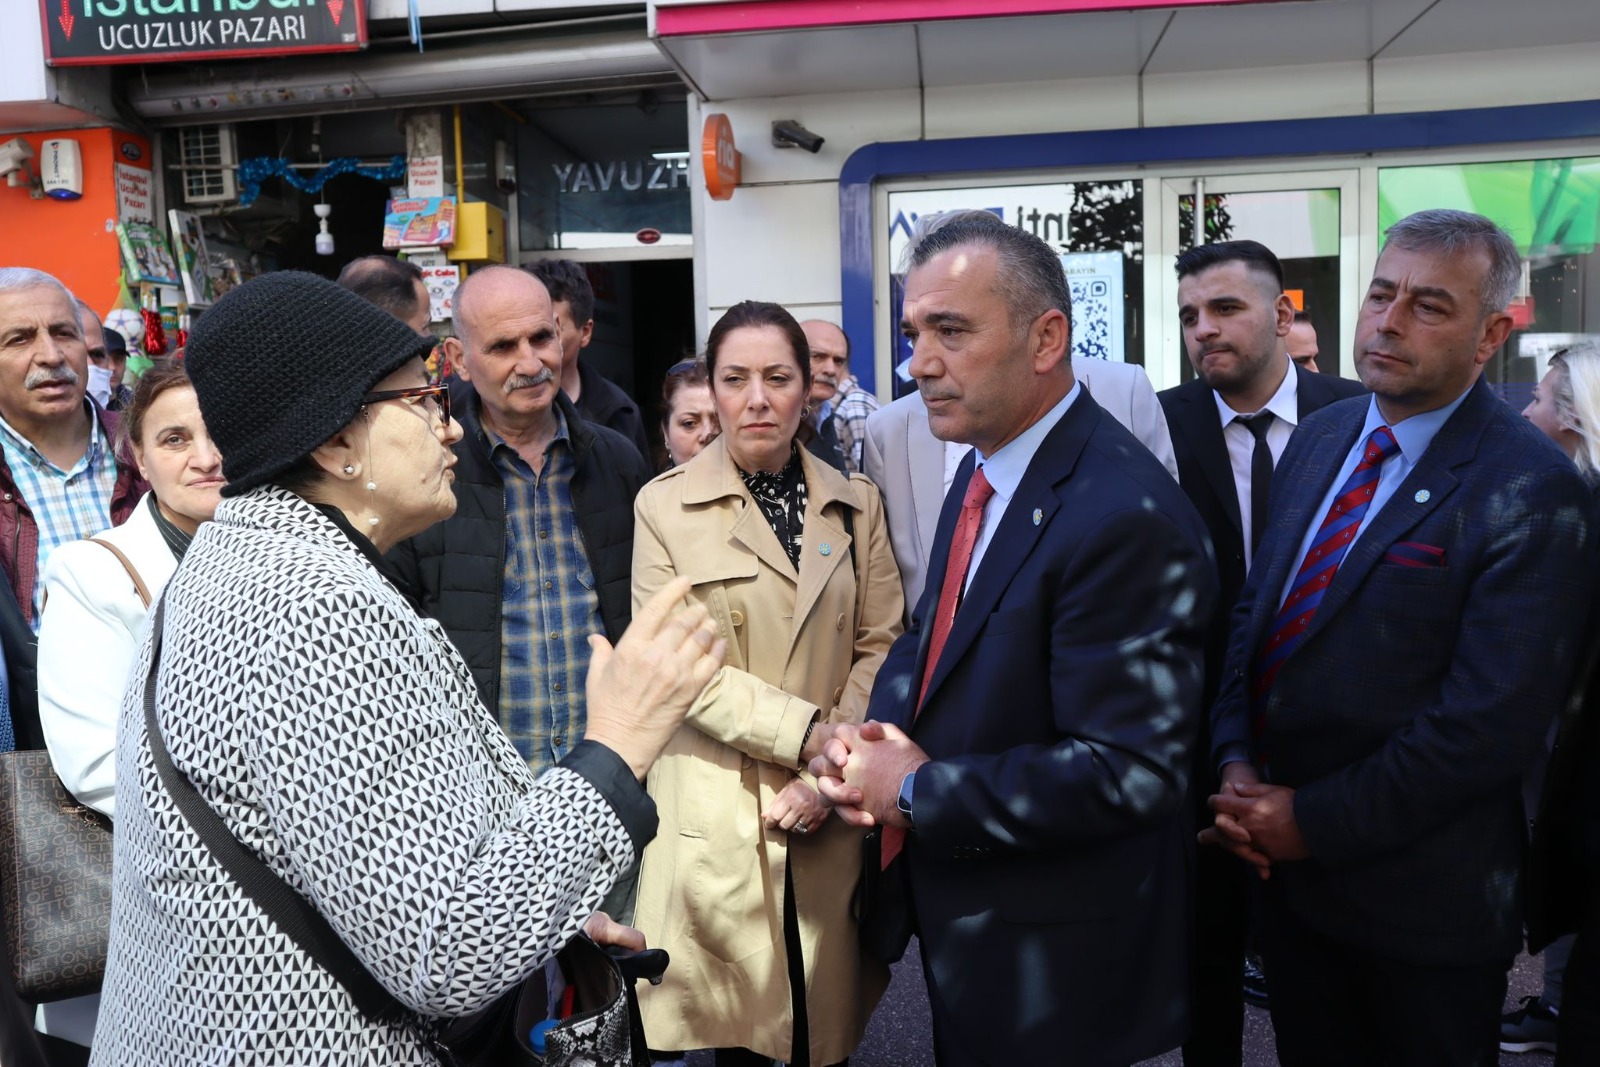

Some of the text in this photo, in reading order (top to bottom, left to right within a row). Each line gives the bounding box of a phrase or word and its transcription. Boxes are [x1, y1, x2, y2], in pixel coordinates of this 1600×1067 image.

[98, 14, 306, 50] UCUZLUK PAZARI
[717, 125, 735, 169] ria
